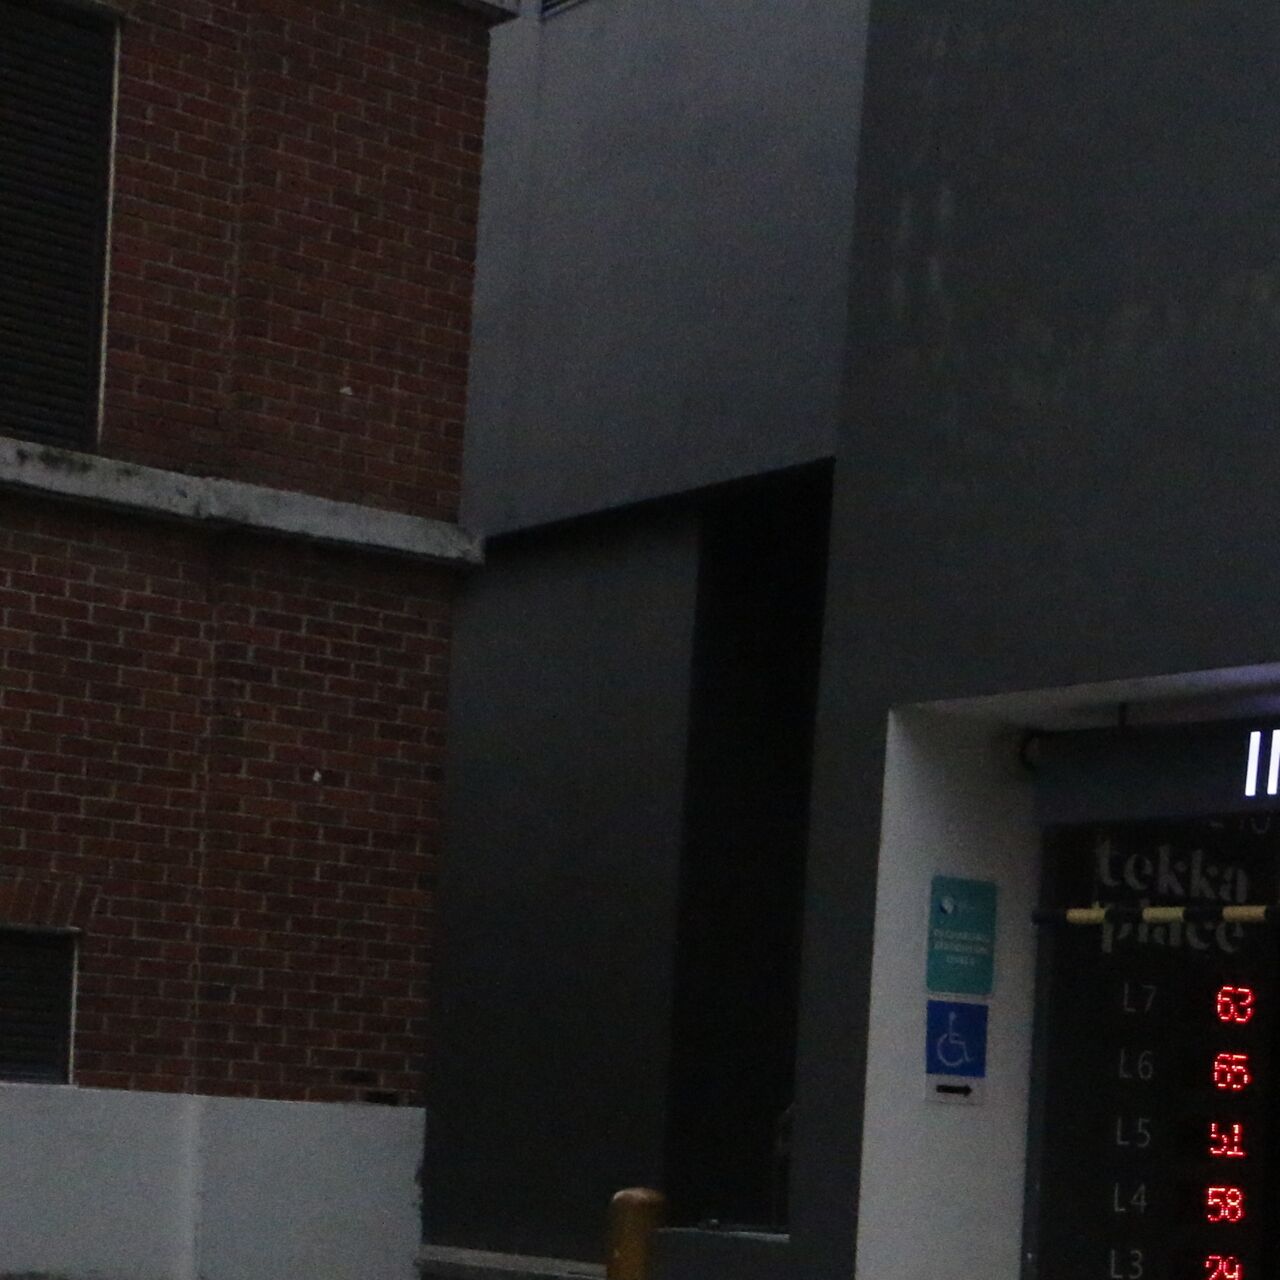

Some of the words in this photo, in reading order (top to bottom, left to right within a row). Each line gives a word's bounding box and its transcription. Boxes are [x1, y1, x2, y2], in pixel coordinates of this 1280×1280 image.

[1096, 834, 1250, 904] tekka
[1123, 981, 1157, 1014] L7
[1215, 984, 1256, 1024] 63
[1119, 1048, 1154, 1080] L6
[1212, 1052, 1253, 1092] 65
[1115, 1115, 1151, 1148] L5
[1207, 1119, 1249, 1159] 51
[1113, 1182, 1149, 1214] L4
[1206, 1185, 1247, 1224] 58
[1110, 1249, 1144, 1280] L3
